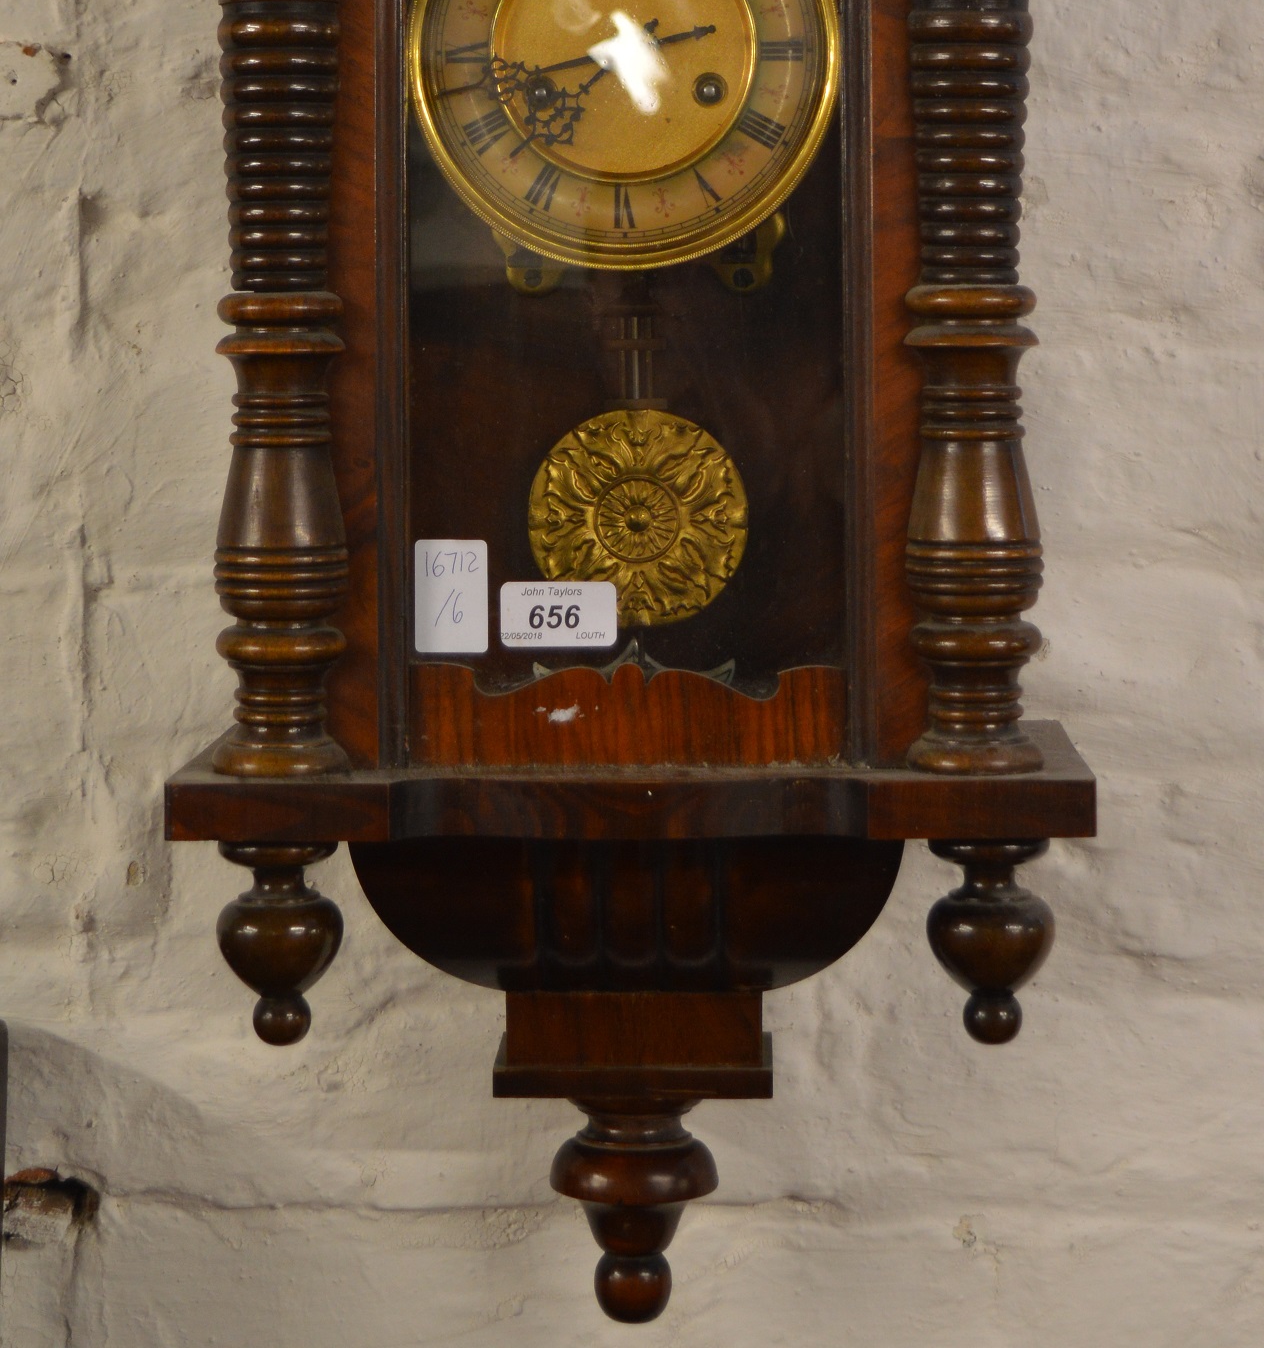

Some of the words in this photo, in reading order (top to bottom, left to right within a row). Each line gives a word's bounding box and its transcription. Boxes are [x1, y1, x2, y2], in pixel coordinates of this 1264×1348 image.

[761, 42, 801, 61] III
[737, 108, 785, 150] IIII
[524, 164, 560, 210] VII
[693, 168, 721, 206] V
[614, 186, 635, 228] VI
[425, 551, 480, 578] 16712
[521, 587, 544, 596] John
[548, 587, 582, 597] Taylors
[529, 605, 581, 629] 656
